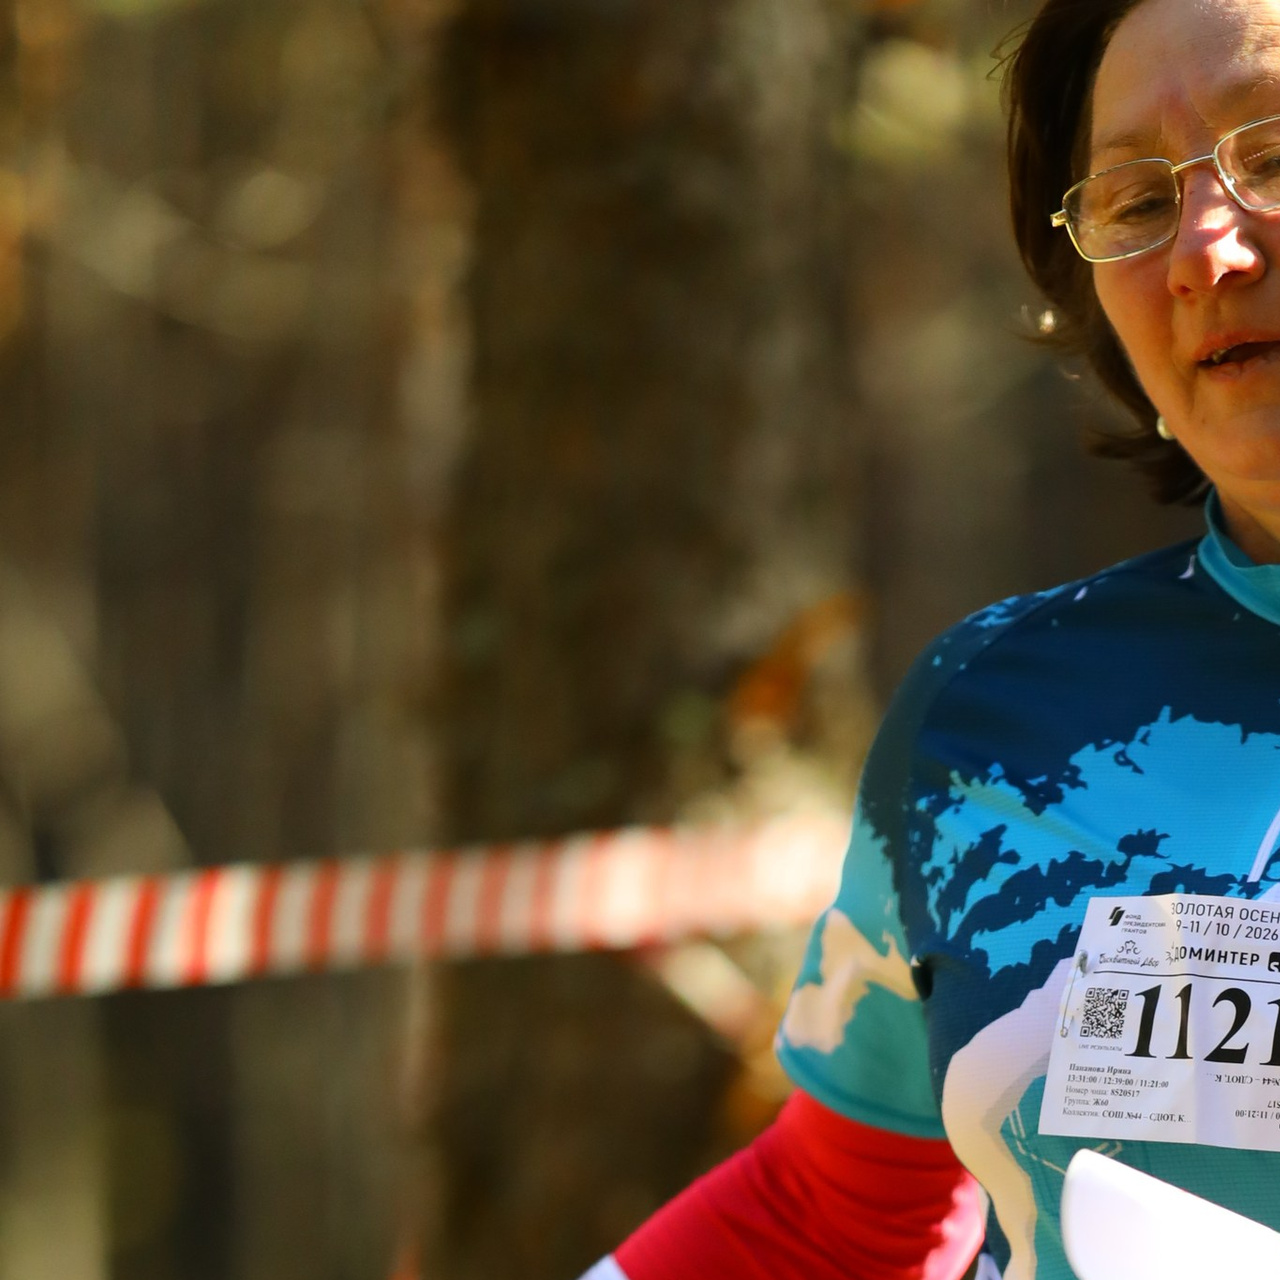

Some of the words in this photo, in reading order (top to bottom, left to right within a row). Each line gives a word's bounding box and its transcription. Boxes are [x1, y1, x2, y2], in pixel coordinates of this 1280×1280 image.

[1171, 902, 1234, 919] ЗОЛОТАЯ
[1216, 922, 1230, 936] 10
[1245, 926, 1279, 941] 2026
[1174, 945, 1260, 966] ДОМИНТЕР
[1106, 1065, 1132, 1076] Ирина
[1067, 1074, 1097, 1084] 13:31:00
[1103, 1077, 1133, 1087] 12:39:00
[1140, 1079, 1169, 1088] 11:21:00
[1262, 1077, 1280, 1087] №44
[1110, 1089, 1140, 1098] 8520517
[1092, 1098, 1109, 1107] Ж60
[1102, 1109, 1123, 1119] СОШ
[1125, 1111, 1142, 1120] №44
[1235, 1109, 1268, 1119] 11:21:00
